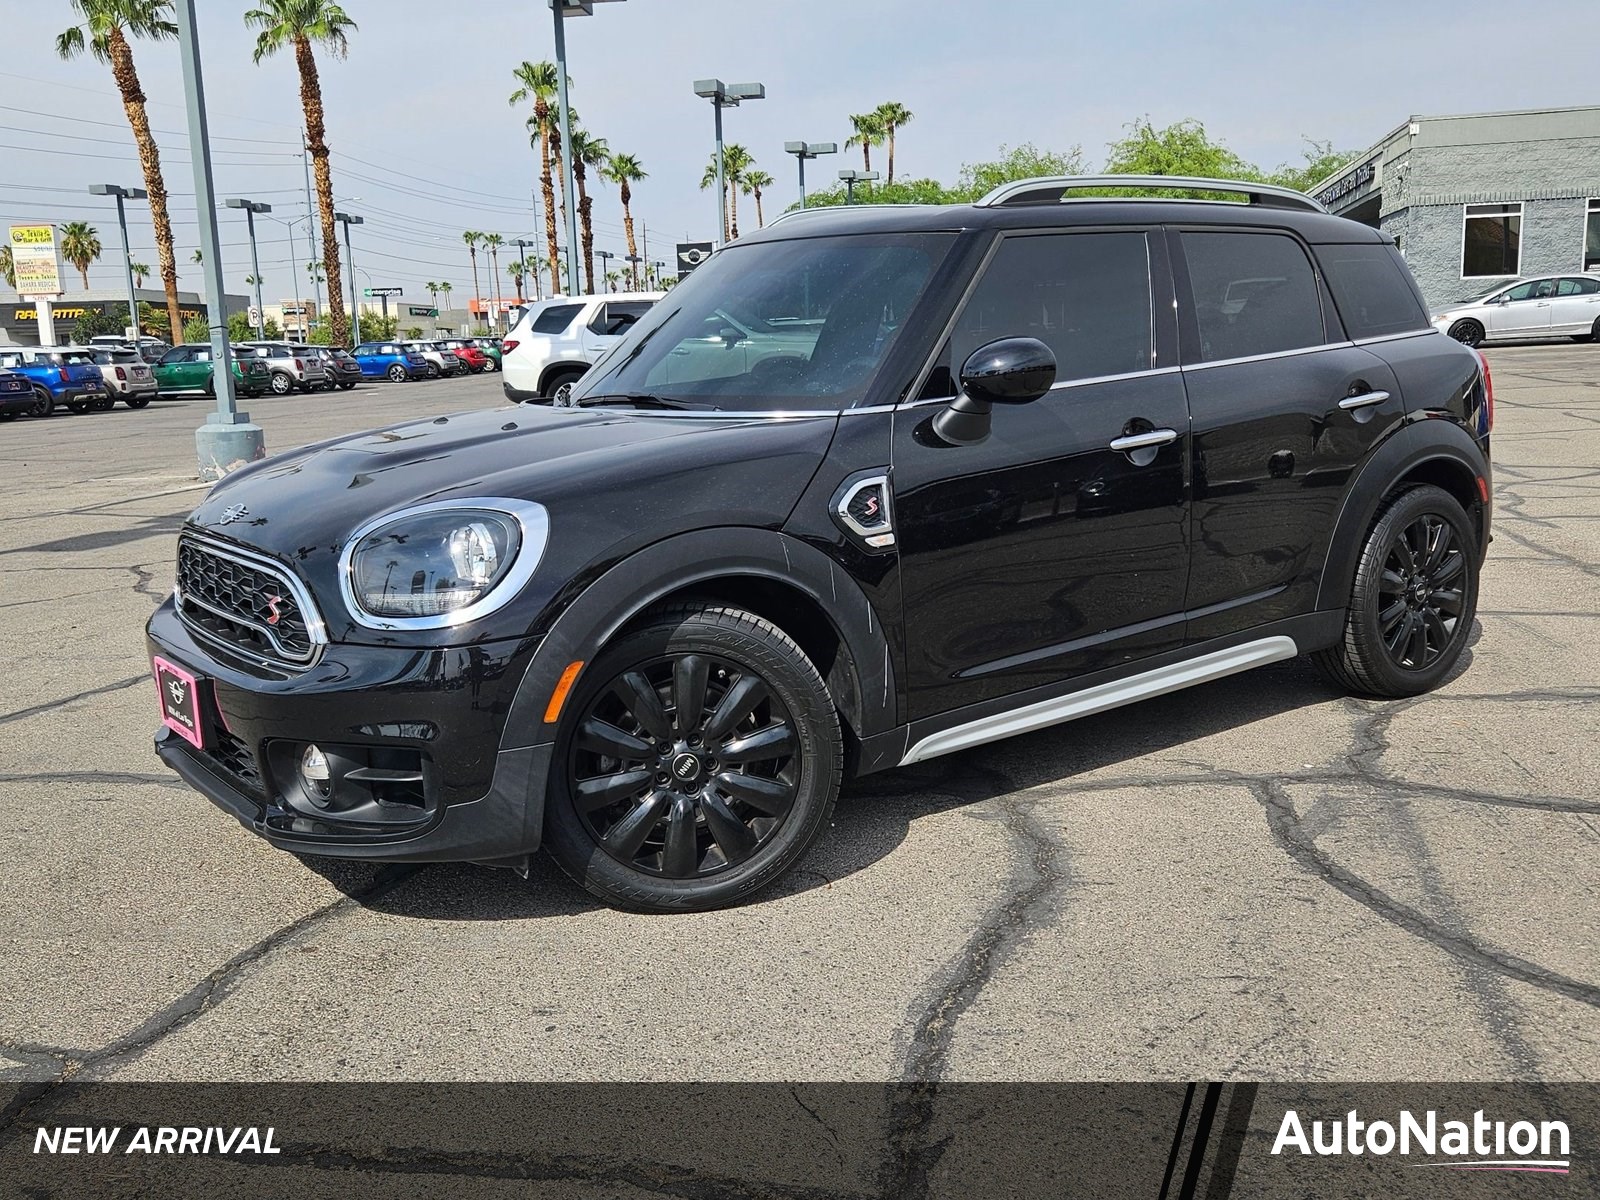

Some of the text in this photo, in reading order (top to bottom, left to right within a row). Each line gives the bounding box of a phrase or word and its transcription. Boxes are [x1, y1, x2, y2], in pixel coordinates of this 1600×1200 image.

[37, 280, 57, 288] MEDICAL
[864, 496, 878, 516] S
[266, 596, 282, 625] S
[677, 757, 695, 776] MINI
